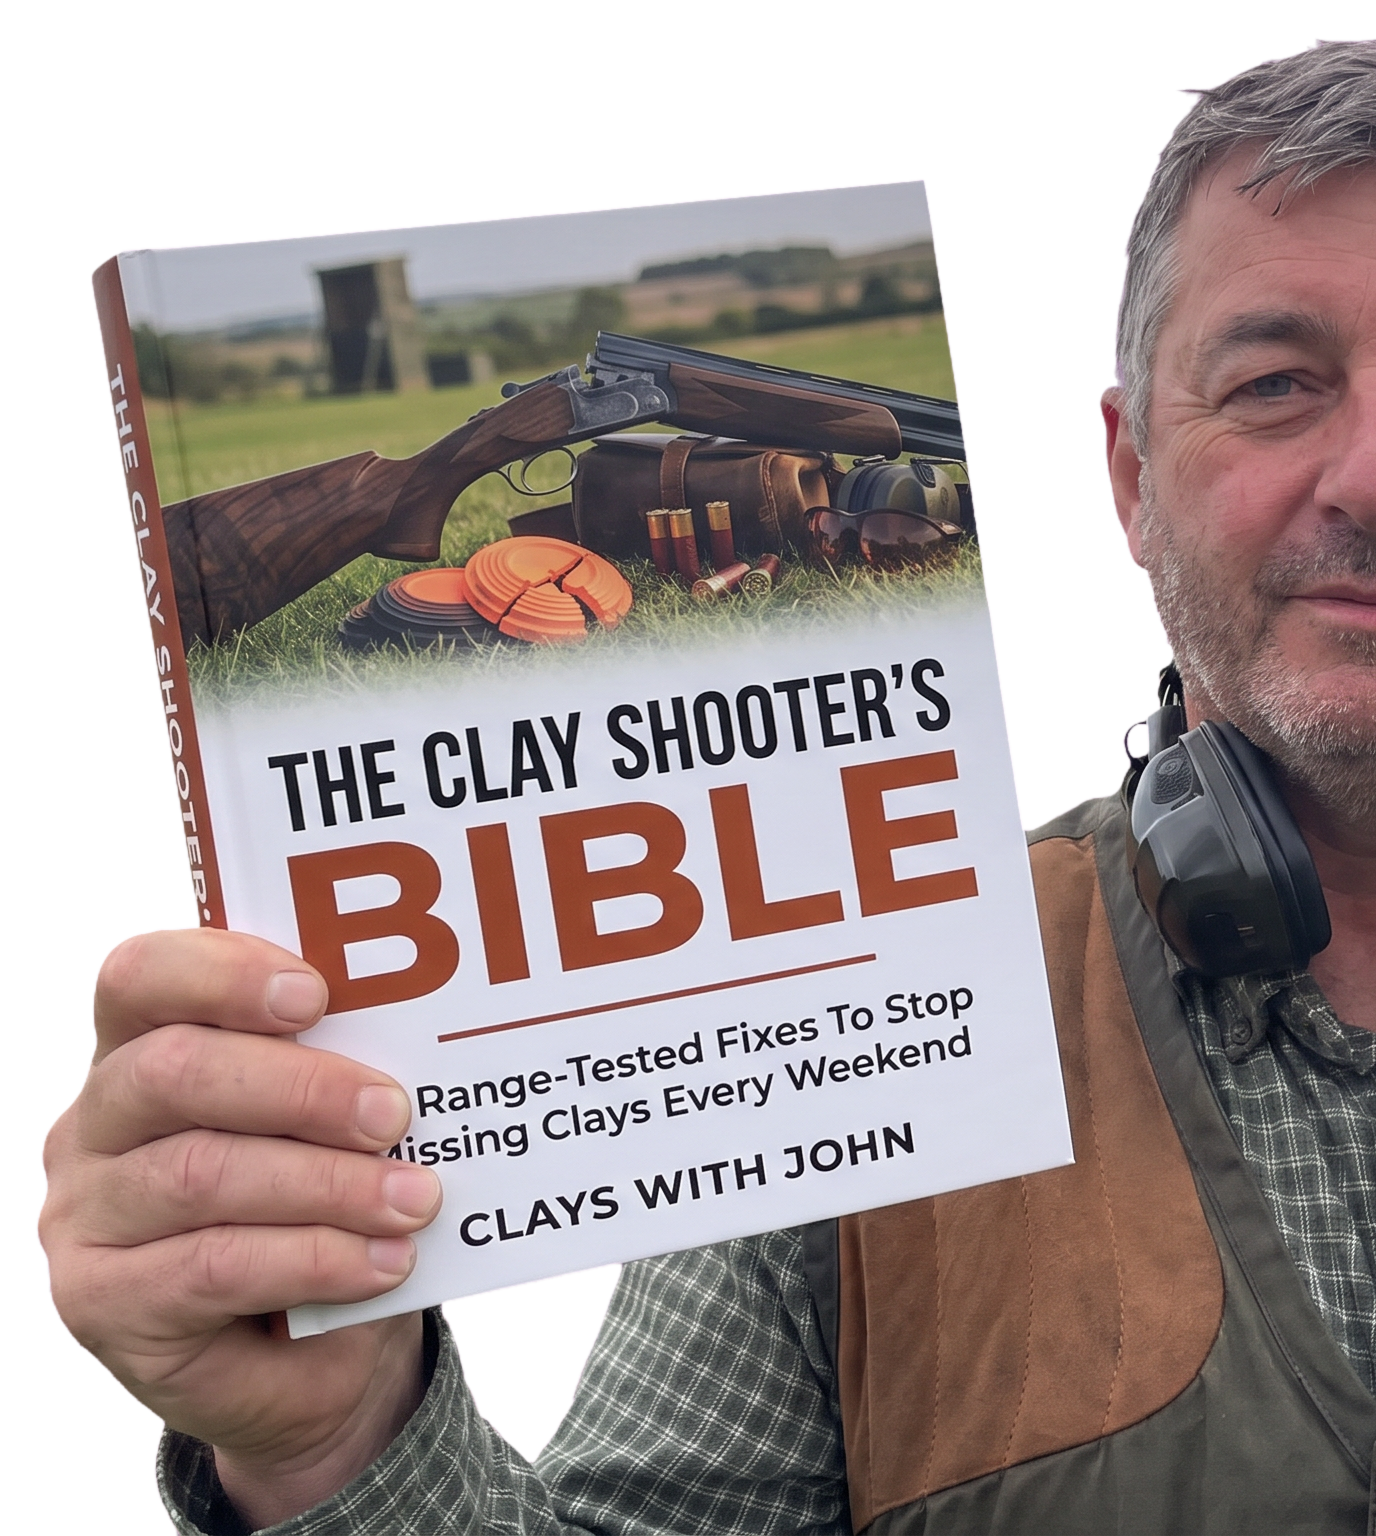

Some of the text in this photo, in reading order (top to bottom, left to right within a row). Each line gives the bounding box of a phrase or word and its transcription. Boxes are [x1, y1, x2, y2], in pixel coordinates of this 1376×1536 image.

[110, 363, 138, 474] THE
[132, 490, 165, 626] CLAY
[268, 659, 950, 831] THE CLAY SHOOTER'S
[287, 749, 978, 1014] BIBLE
[417, 988, 973, 1117] Range-Tested Fixes To Stop
[543, 1100, 650, 1140] Clays
[664, 1074, 773, 1117] Every
[785, 1026, 971, 1090] Weekend
[460, 1123, 914, 1246] CLAYS WITH JOHN
